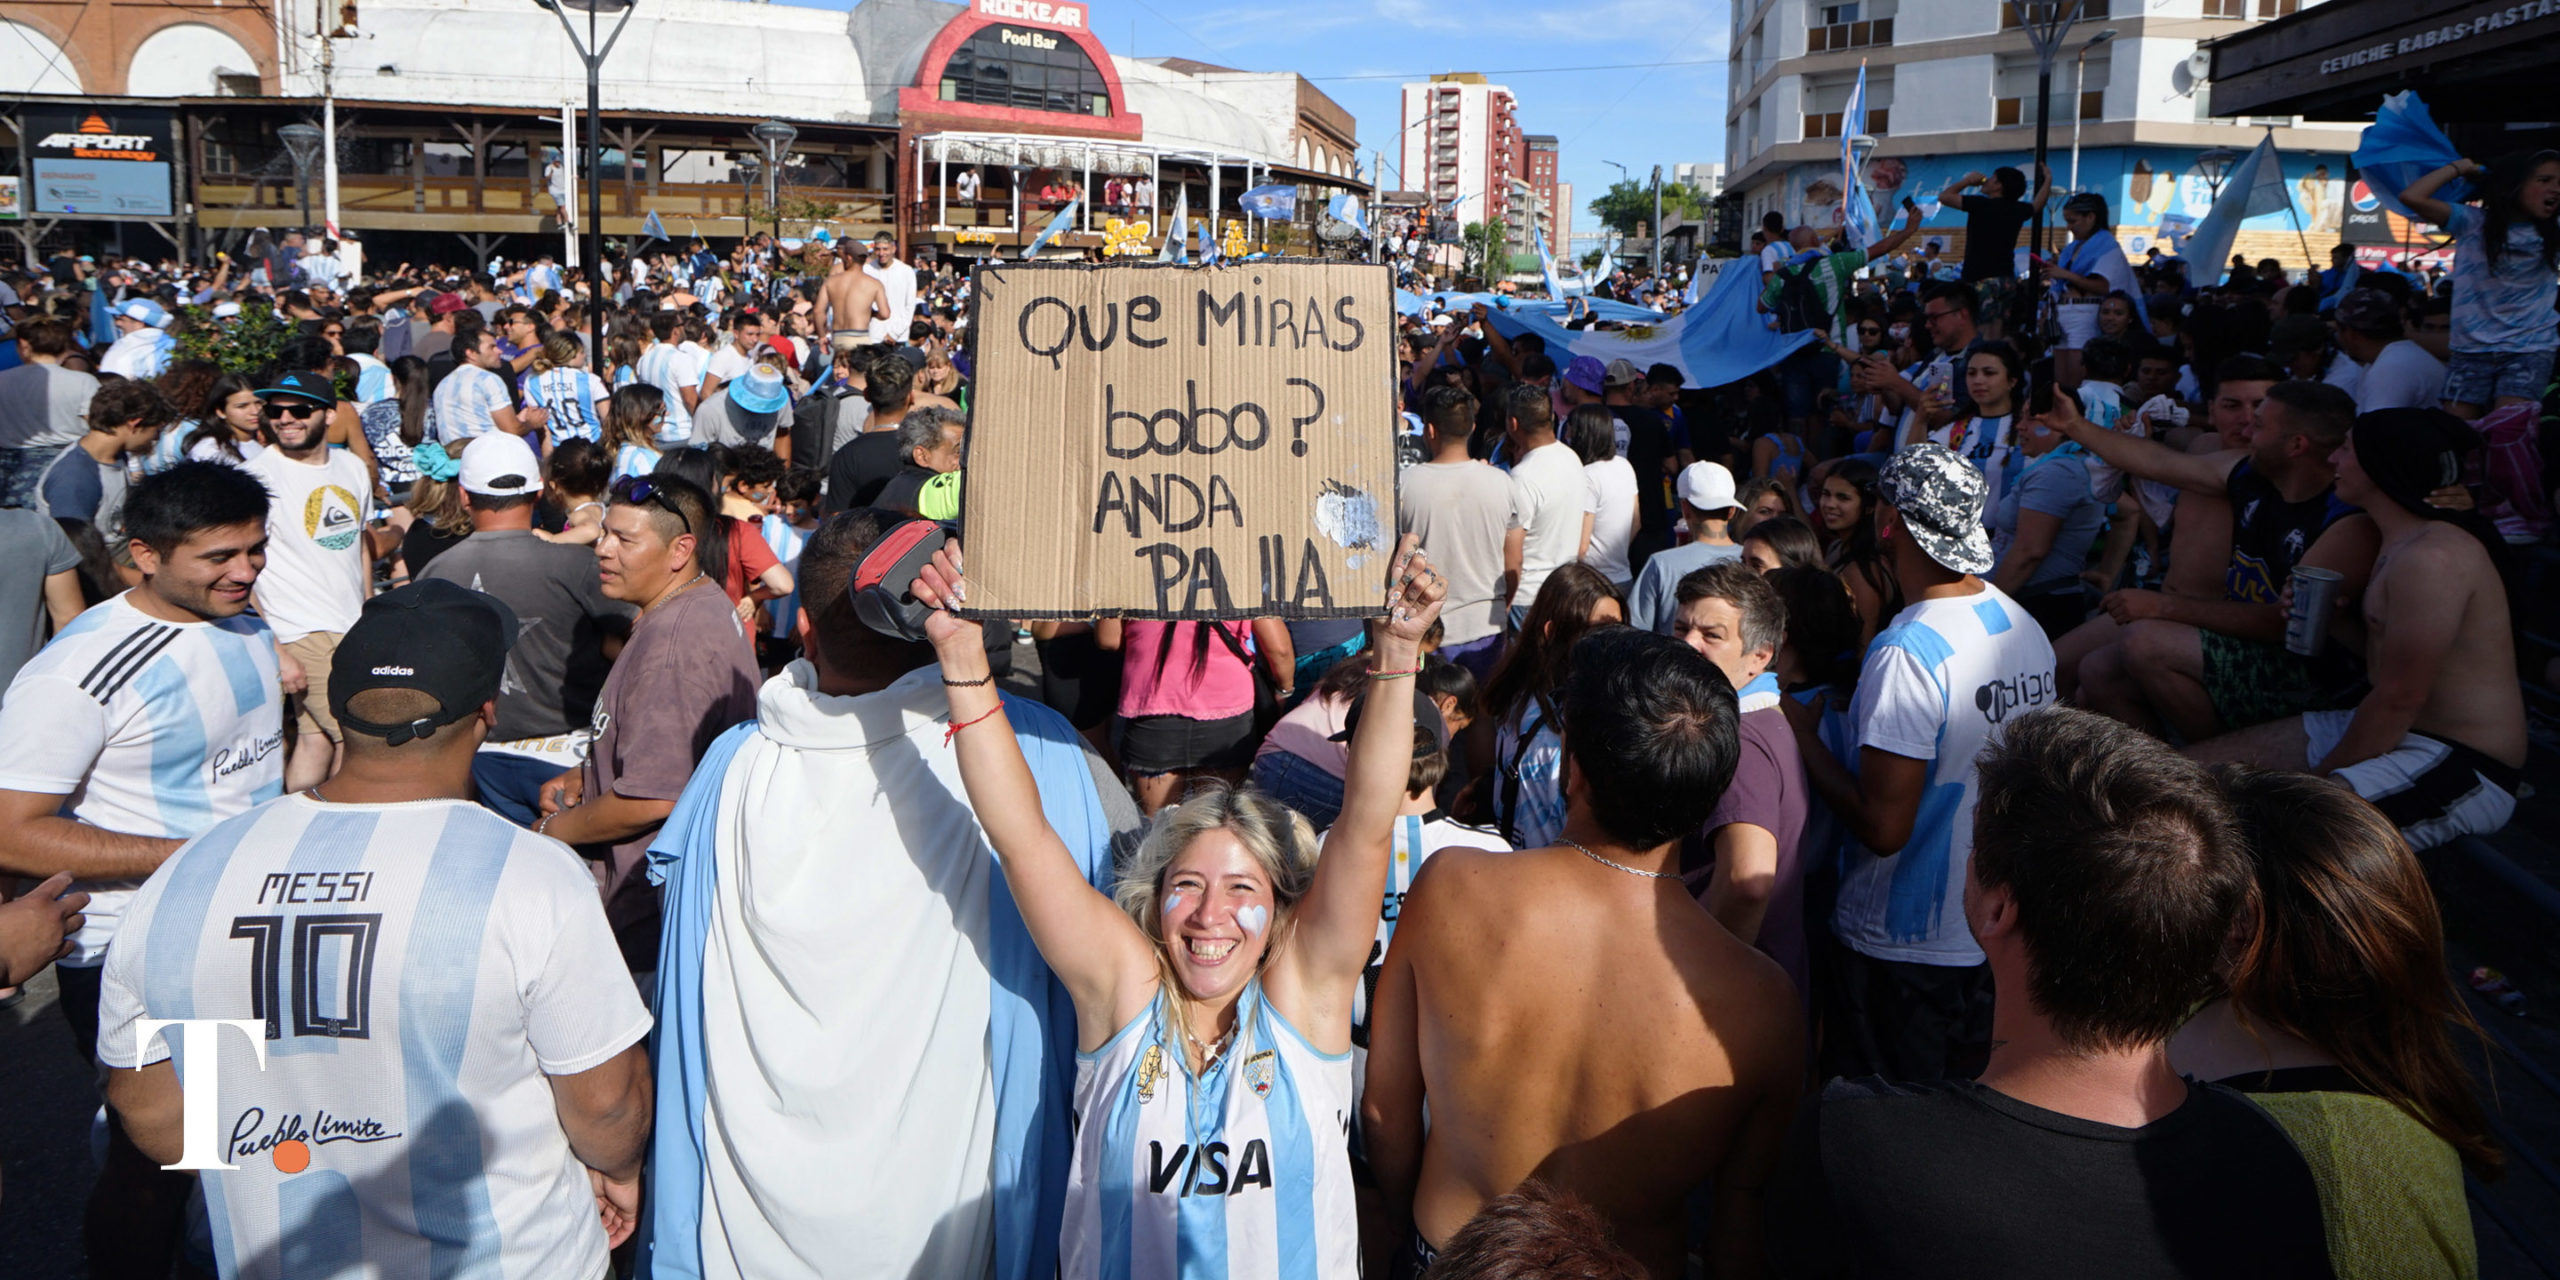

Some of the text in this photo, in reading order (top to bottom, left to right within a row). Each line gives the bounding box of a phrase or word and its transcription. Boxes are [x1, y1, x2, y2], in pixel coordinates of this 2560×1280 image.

[980, 0, 1081, 28] ROCKEAR
[1001, 29, 1057, 50] Pool Bar
[2320, 43, 2394, 75] CEVICHE
[37, 133, 153, 150] AIRPORT
[1701, 264, 1723, 275] PA
[543, 382, 573, 393] MESSI
[547, 397, 586, 430] 10
[1092, 471, 1244, 539] ANDA
[371, 665, 414, 676] adidas
[212, 748, 254, 784] Pueblo
[257, 871, 374, 904] MESSI
[229, 913, 383, 1040] 10
[228, 1107, 310, 1164] Pueblo
[1149, 1138, 1272, 1198] VISA
